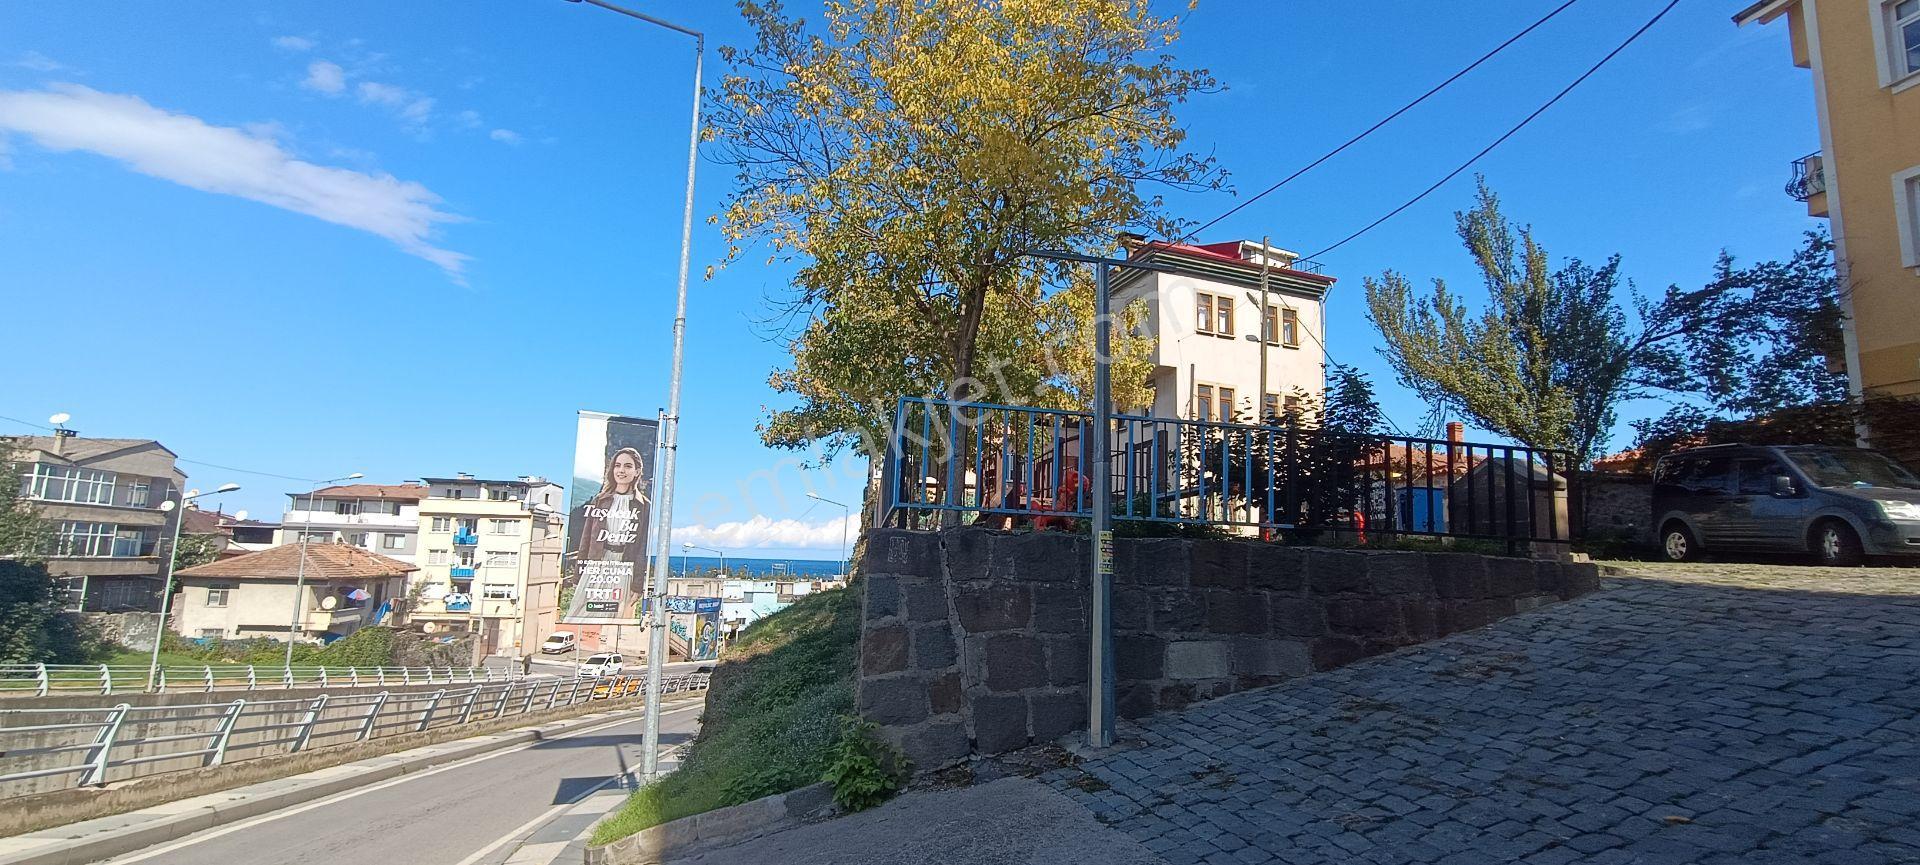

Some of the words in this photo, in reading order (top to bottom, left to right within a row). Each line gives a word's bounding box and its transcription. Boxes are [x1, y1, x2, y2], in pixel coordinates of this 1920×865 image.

[619, 519, 639, 532] Bu
[596, 529, 637, 543] Deniz
[578, 566, 601, 575] HER
[603, 567, 633, 576] CUMA
